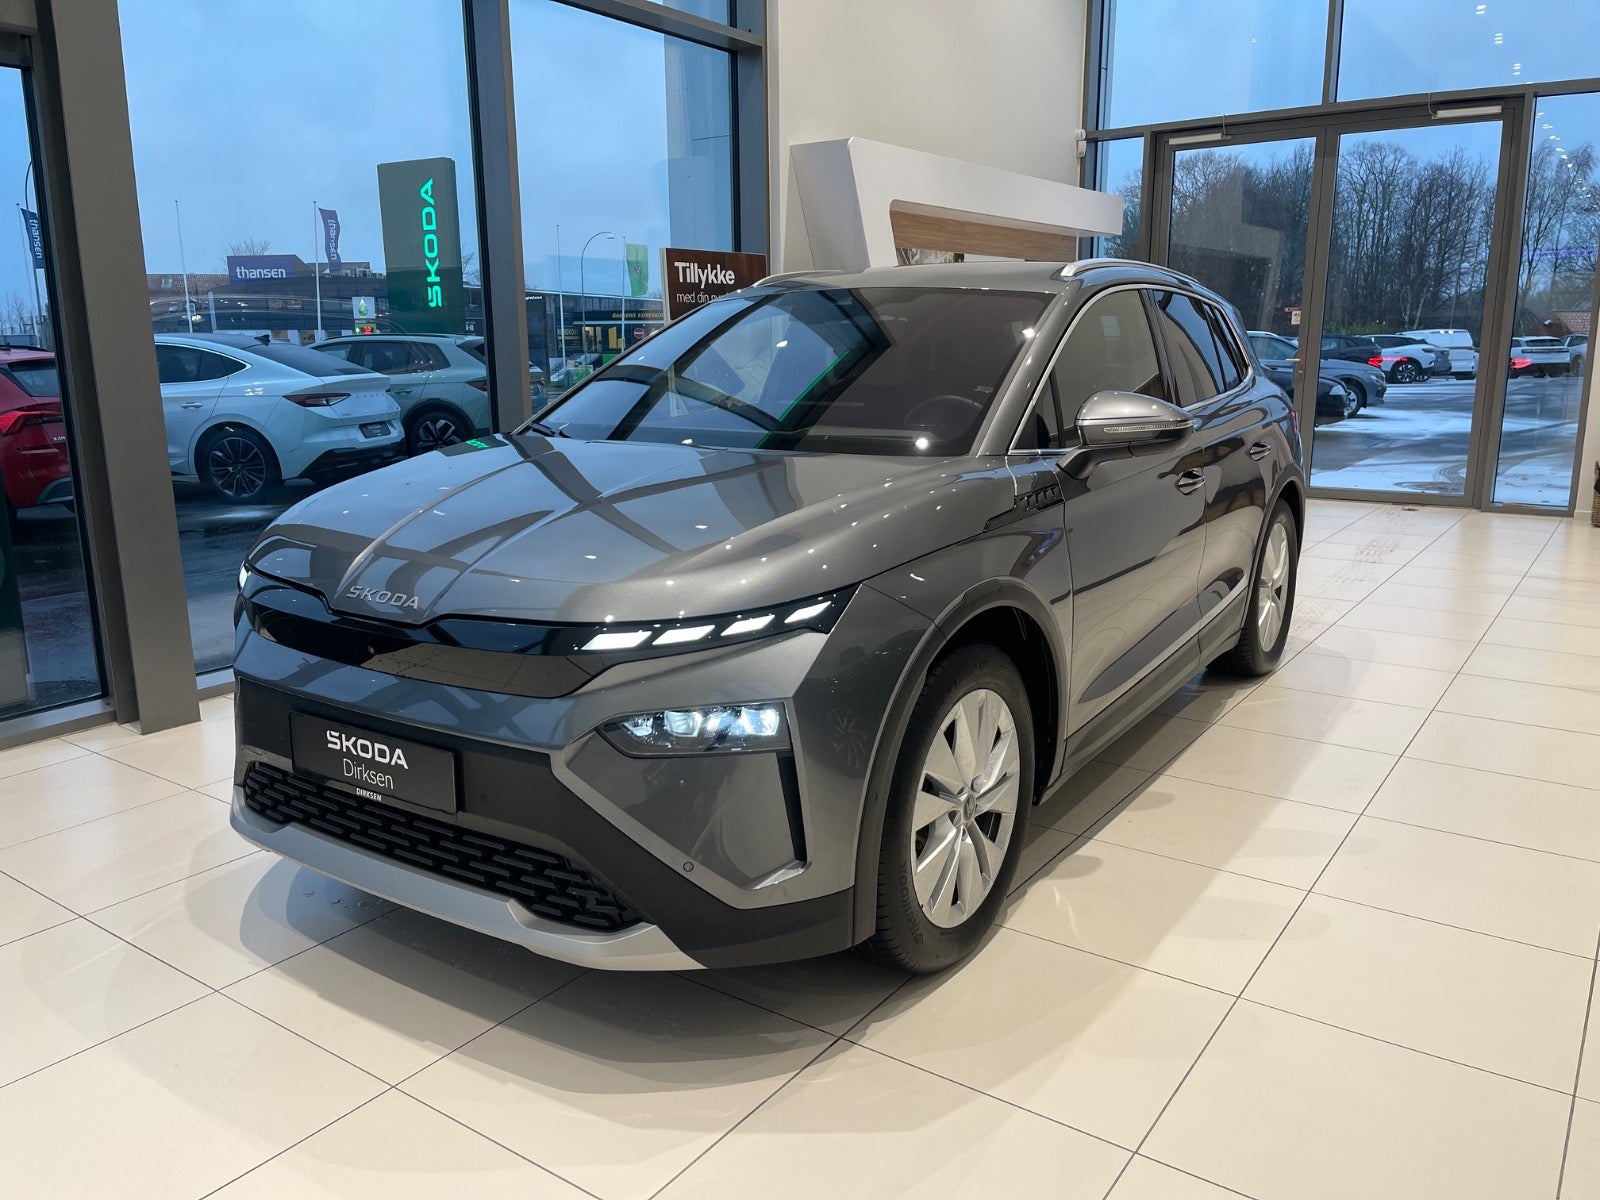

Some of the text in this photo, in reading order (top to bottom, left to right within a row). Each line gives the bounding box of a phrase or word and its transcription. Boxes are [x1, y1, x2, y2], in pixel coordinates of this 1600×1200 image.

[29, 219, 43, 259] thansen
[327, 219, 337, 260] thansen
[235, 266, 286, 279] thansen
[674, 261, 735, 289] Tillykke
[676, 291, 696, 303] med
[697, 292, 710, 303] din
[343, 758, 394, 790] Dirksen
[356, 787, 382, 802] DIRKSEN
